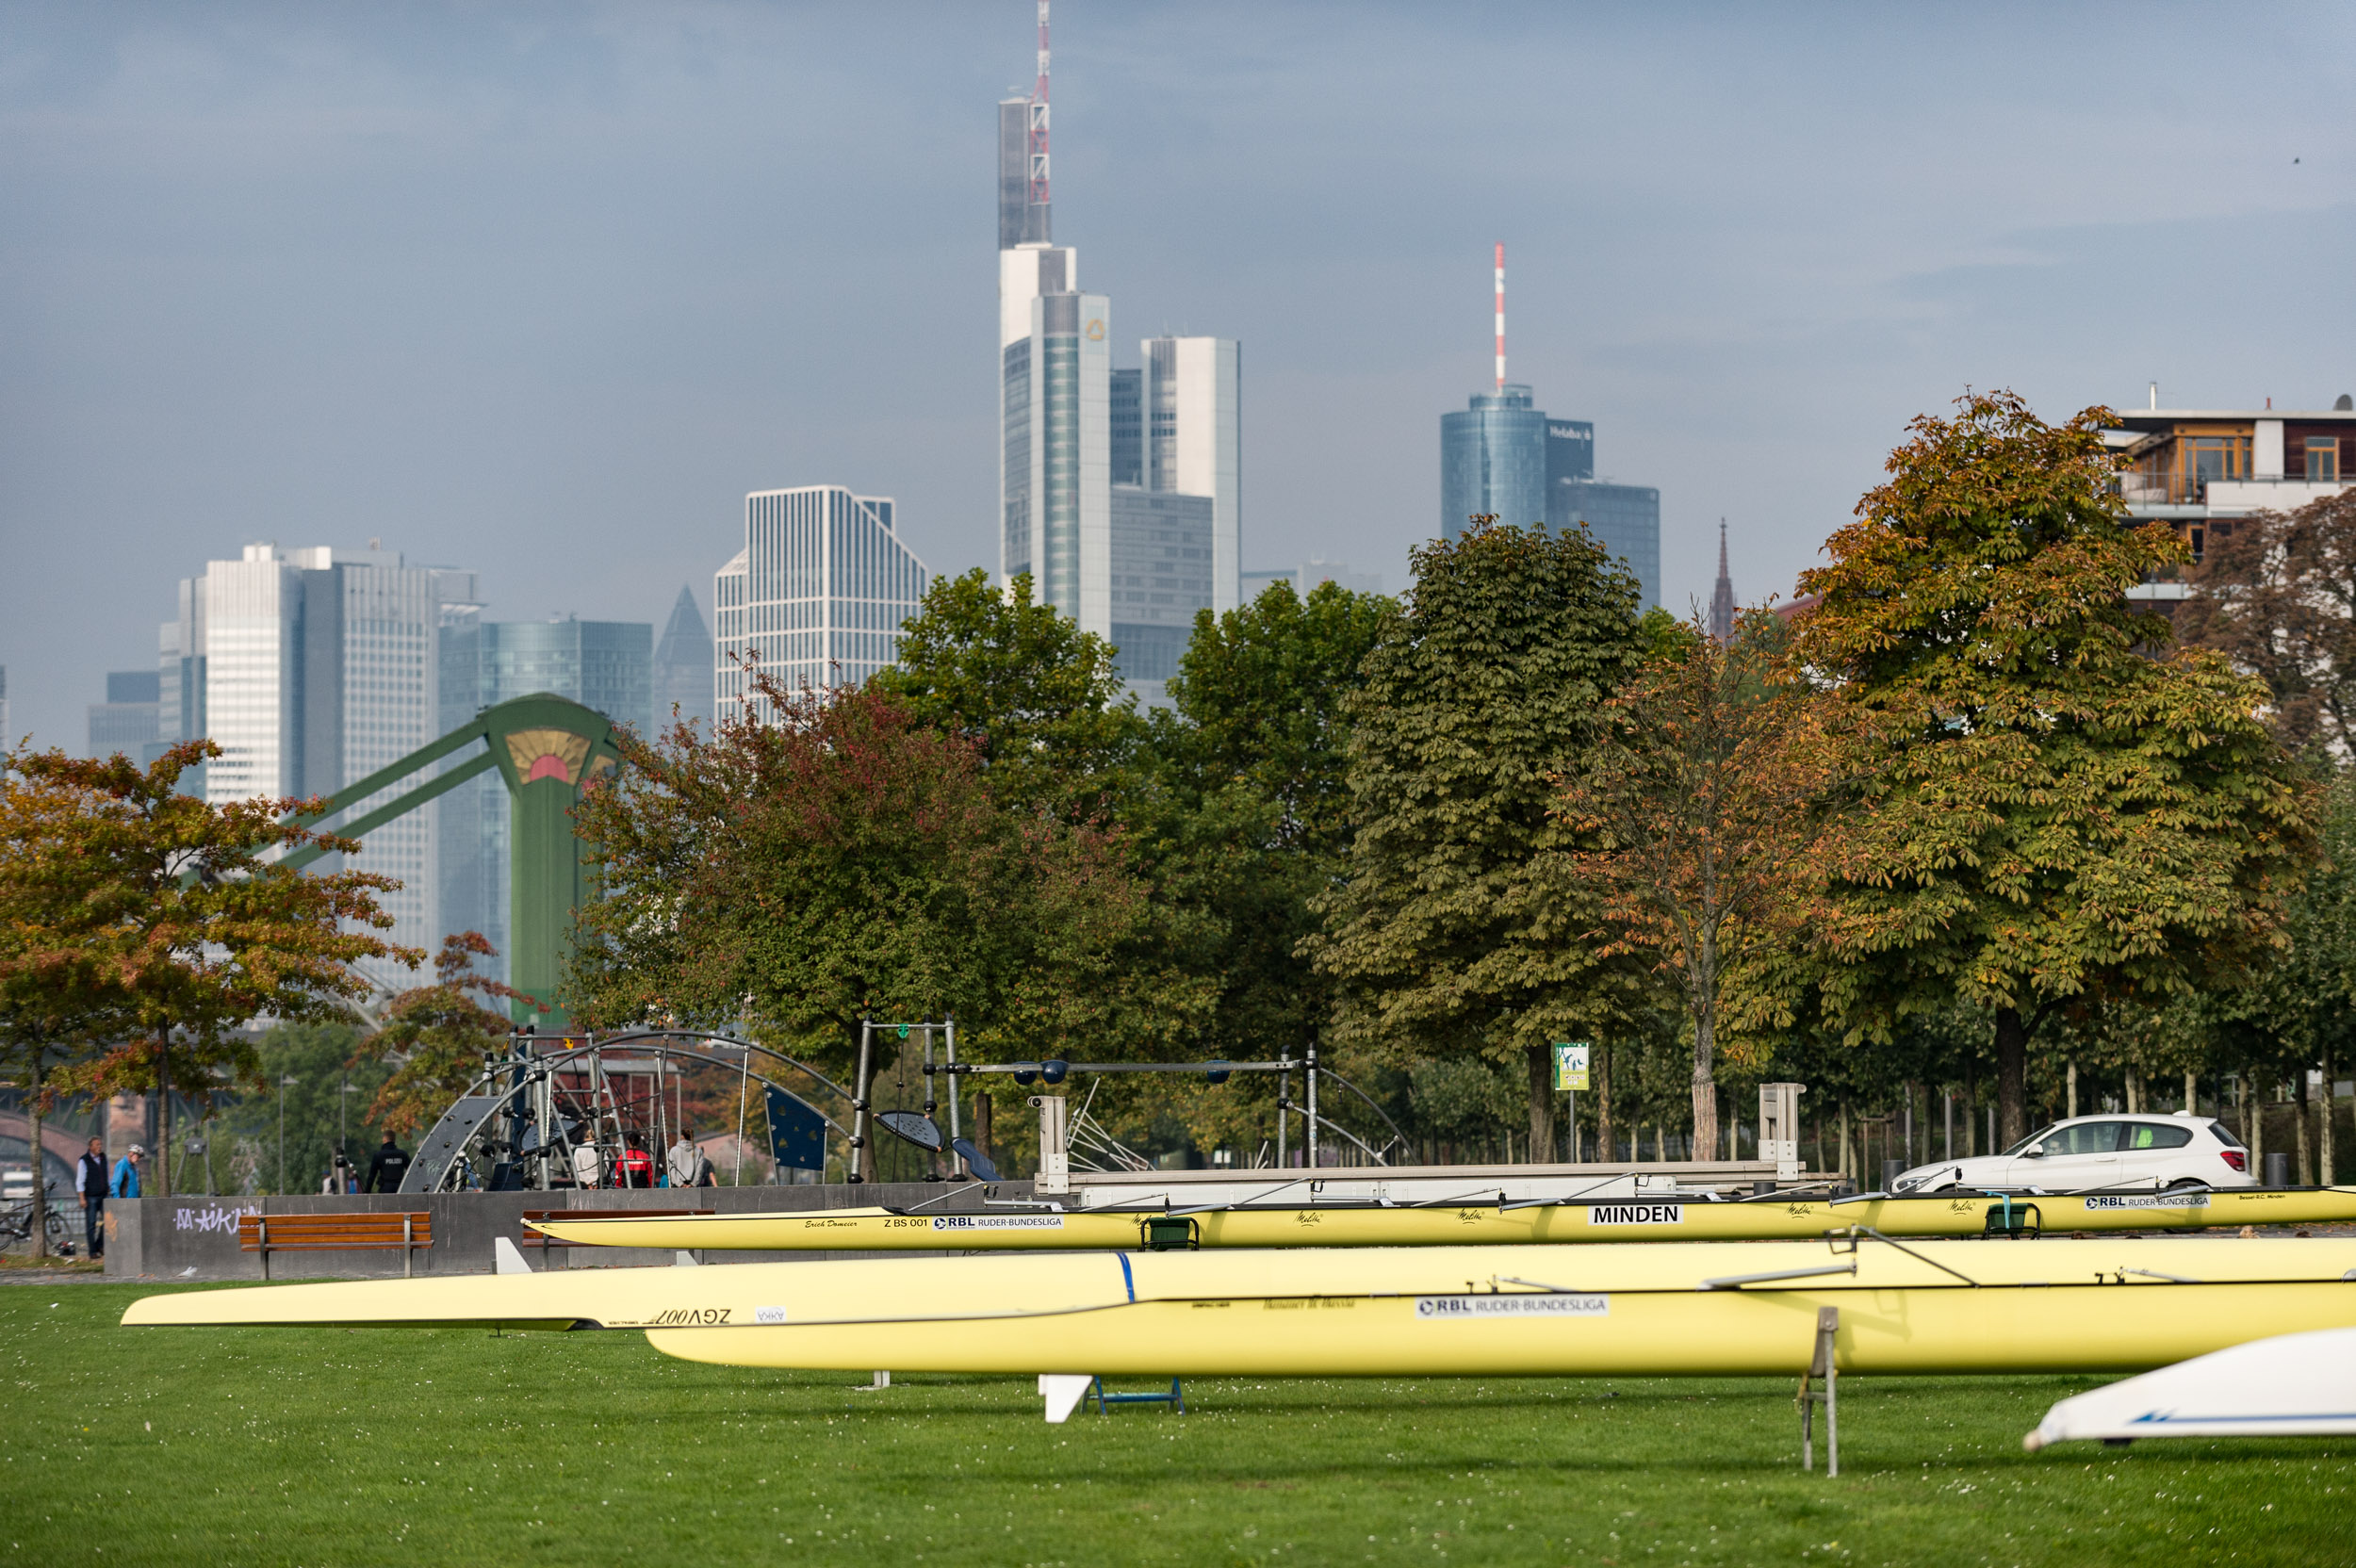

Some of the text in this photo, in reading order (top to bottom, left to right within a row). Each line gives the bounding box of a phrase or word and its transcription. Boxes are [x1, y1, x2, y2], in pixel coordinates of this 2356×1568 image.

[1945, 1199, 1973, 1212] Melitta
[2100, 1197, 2126, 1206] RBL
[1454, 1207, 1482, 1221] Melitta
[1594, 1205, 1678, 1223] MINDEN
[1785, 1201, 1811, 1216] Melitta
[884, 1218, 927, 1228] Z BS 001
[948, 1217, 1062, 1228] RBL RUDER-BUNDESLIGA
[1293, 1210, 1321, 1224] Melitta
[805, 1219, 858, 1229] Erich Domeier
[1437, 1298, 1606, 1312] RBL RUDER-BUNDESLIGA
